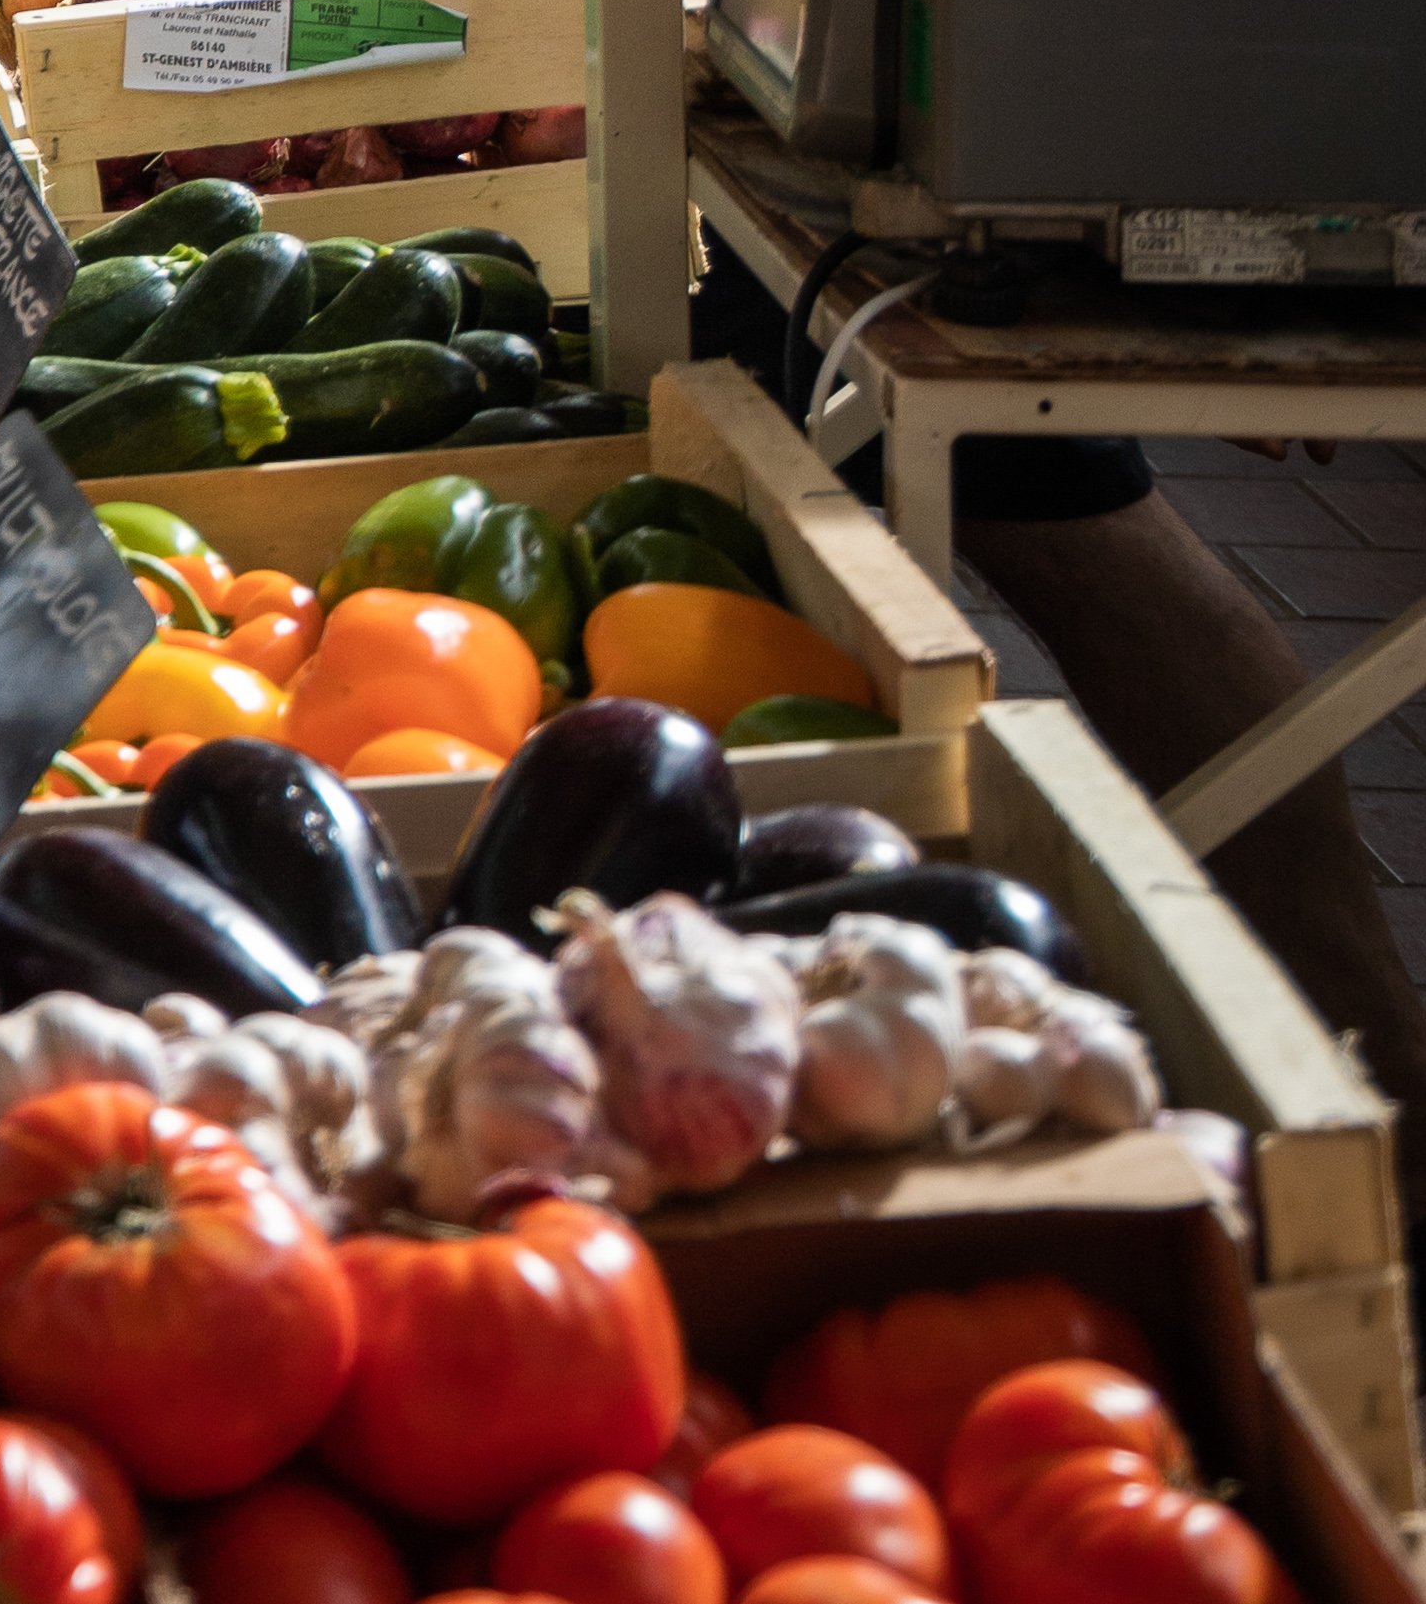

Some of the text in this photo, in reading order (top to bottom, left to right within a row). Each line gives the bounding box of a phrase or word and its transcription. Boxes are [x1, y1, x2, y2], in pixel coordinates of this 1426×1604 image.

[311, 3, 359, 16] FRANCE
[205, 13, 271, 27] TRANCHANT
[162, 22, 201, 34] Laurent
[215, 27, 257, 38] Nathalie
[190, 40, 225, 53] 86140
[142, 53, 272, 74] ST-GENEST D'AMBIÈRE
